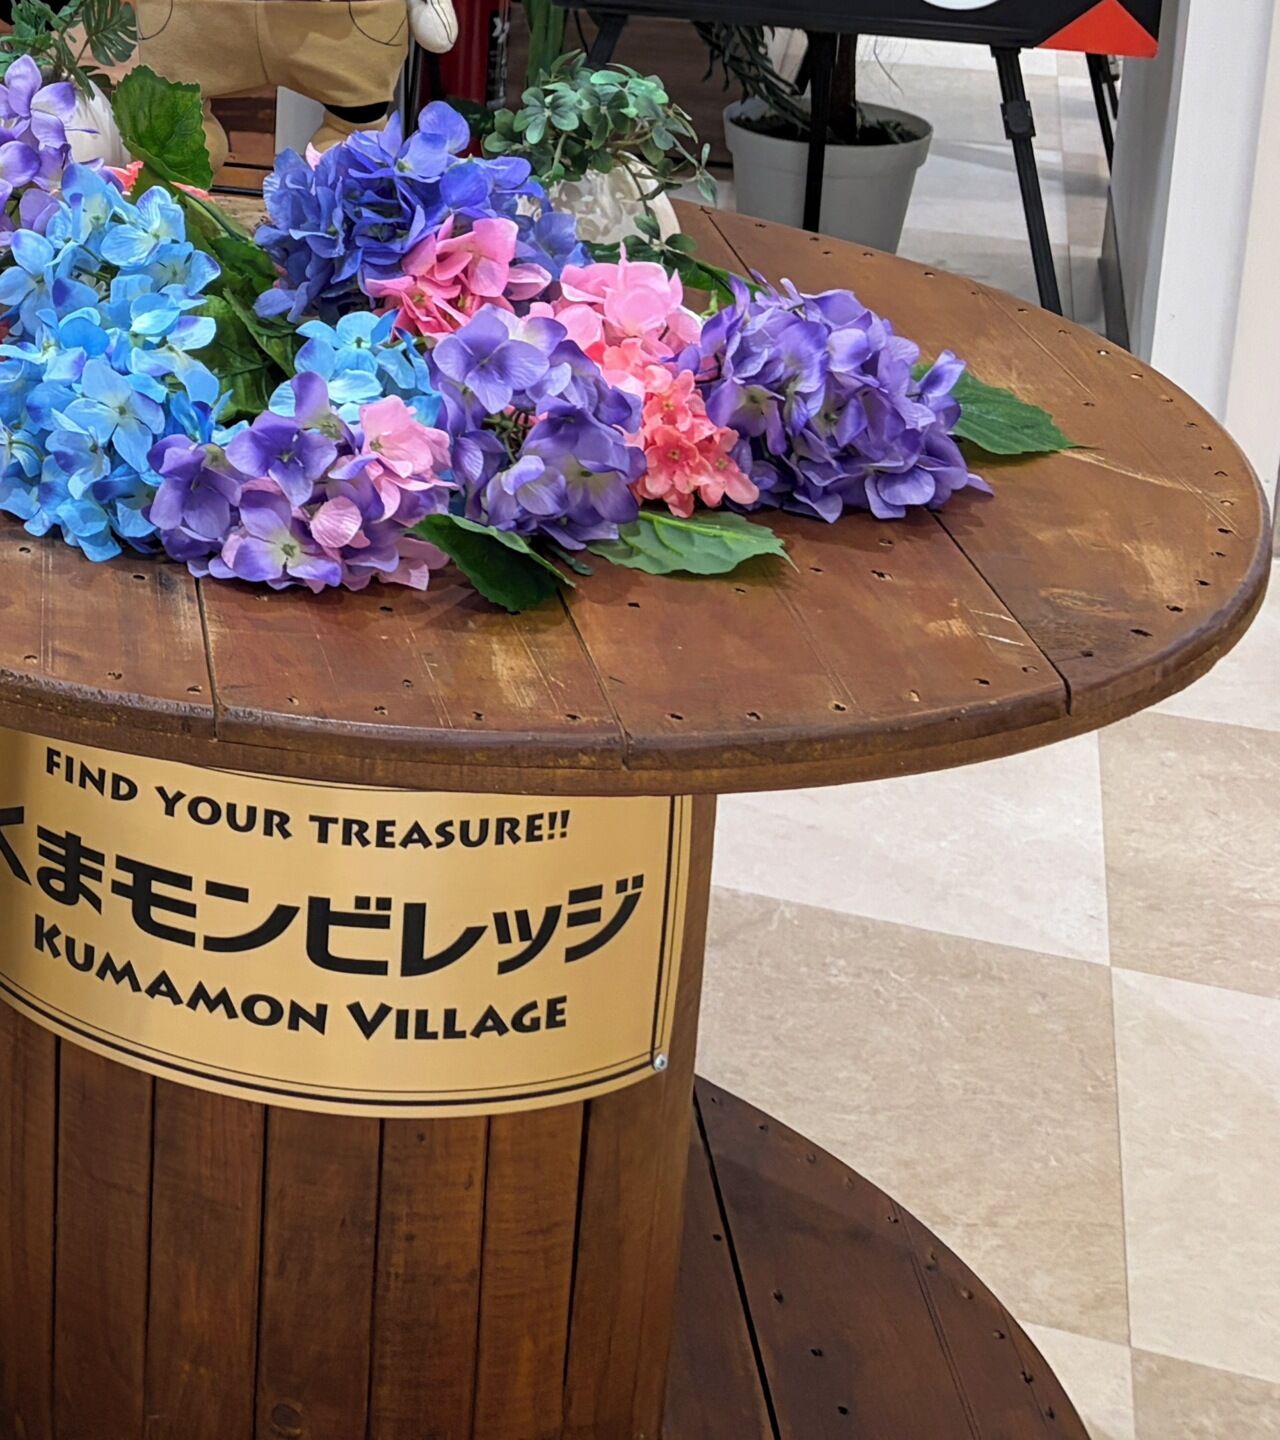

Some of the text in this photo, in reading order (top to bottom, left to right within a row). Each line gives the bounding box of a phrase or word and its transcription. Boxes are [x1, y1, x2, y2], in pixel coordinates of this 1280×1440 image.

[45, 747, 571, 850] FIND YOUR TREASURE!!
[33, 914, 568, 1041] KUMAMON VILLAGE
